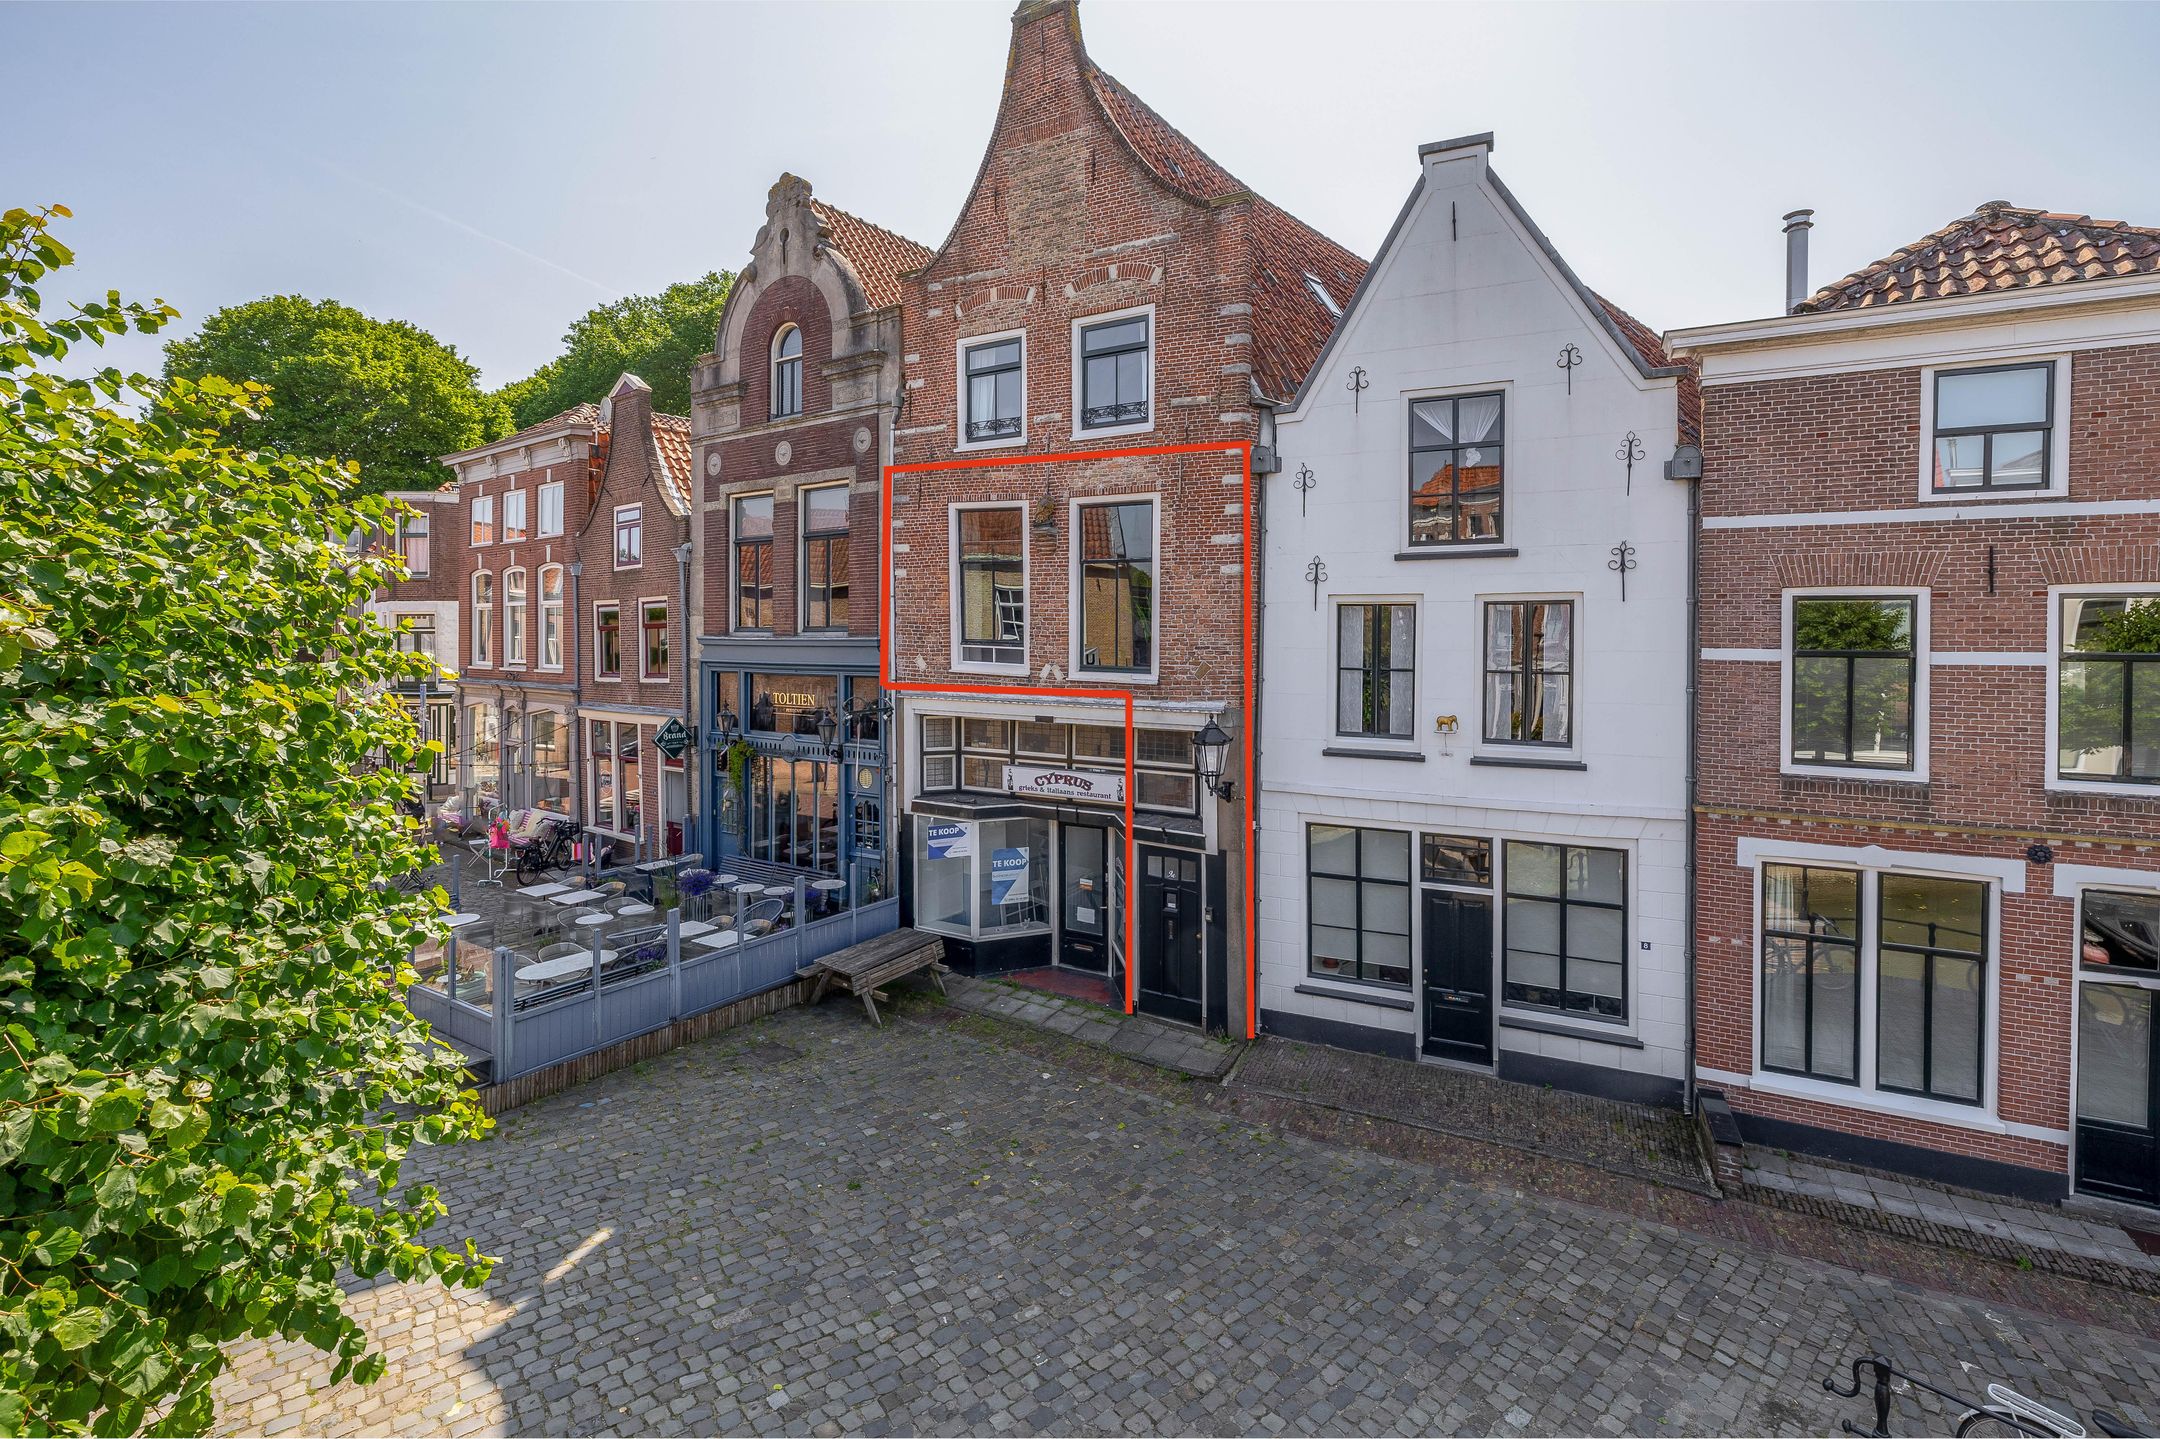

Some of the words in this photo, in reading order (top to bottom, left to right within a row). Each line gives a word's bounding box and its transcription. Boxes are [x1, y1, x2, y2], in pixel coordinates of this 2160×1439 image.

[773, 692, 815, 706] TOLTIEN
[663, 731, 687, 741] Brand
[1034, 772, 1093, 791] CYPRUS
[1047, 787, 1075, 796] italiaans
[1076, 790, 1112, 799] restaurant
[929, 829, 938, 837] TE
[939, 827, 960, 836] KOOP
[993, 860, 1002, 868] TE
[1004, 858, 1027, 867] KOOP
